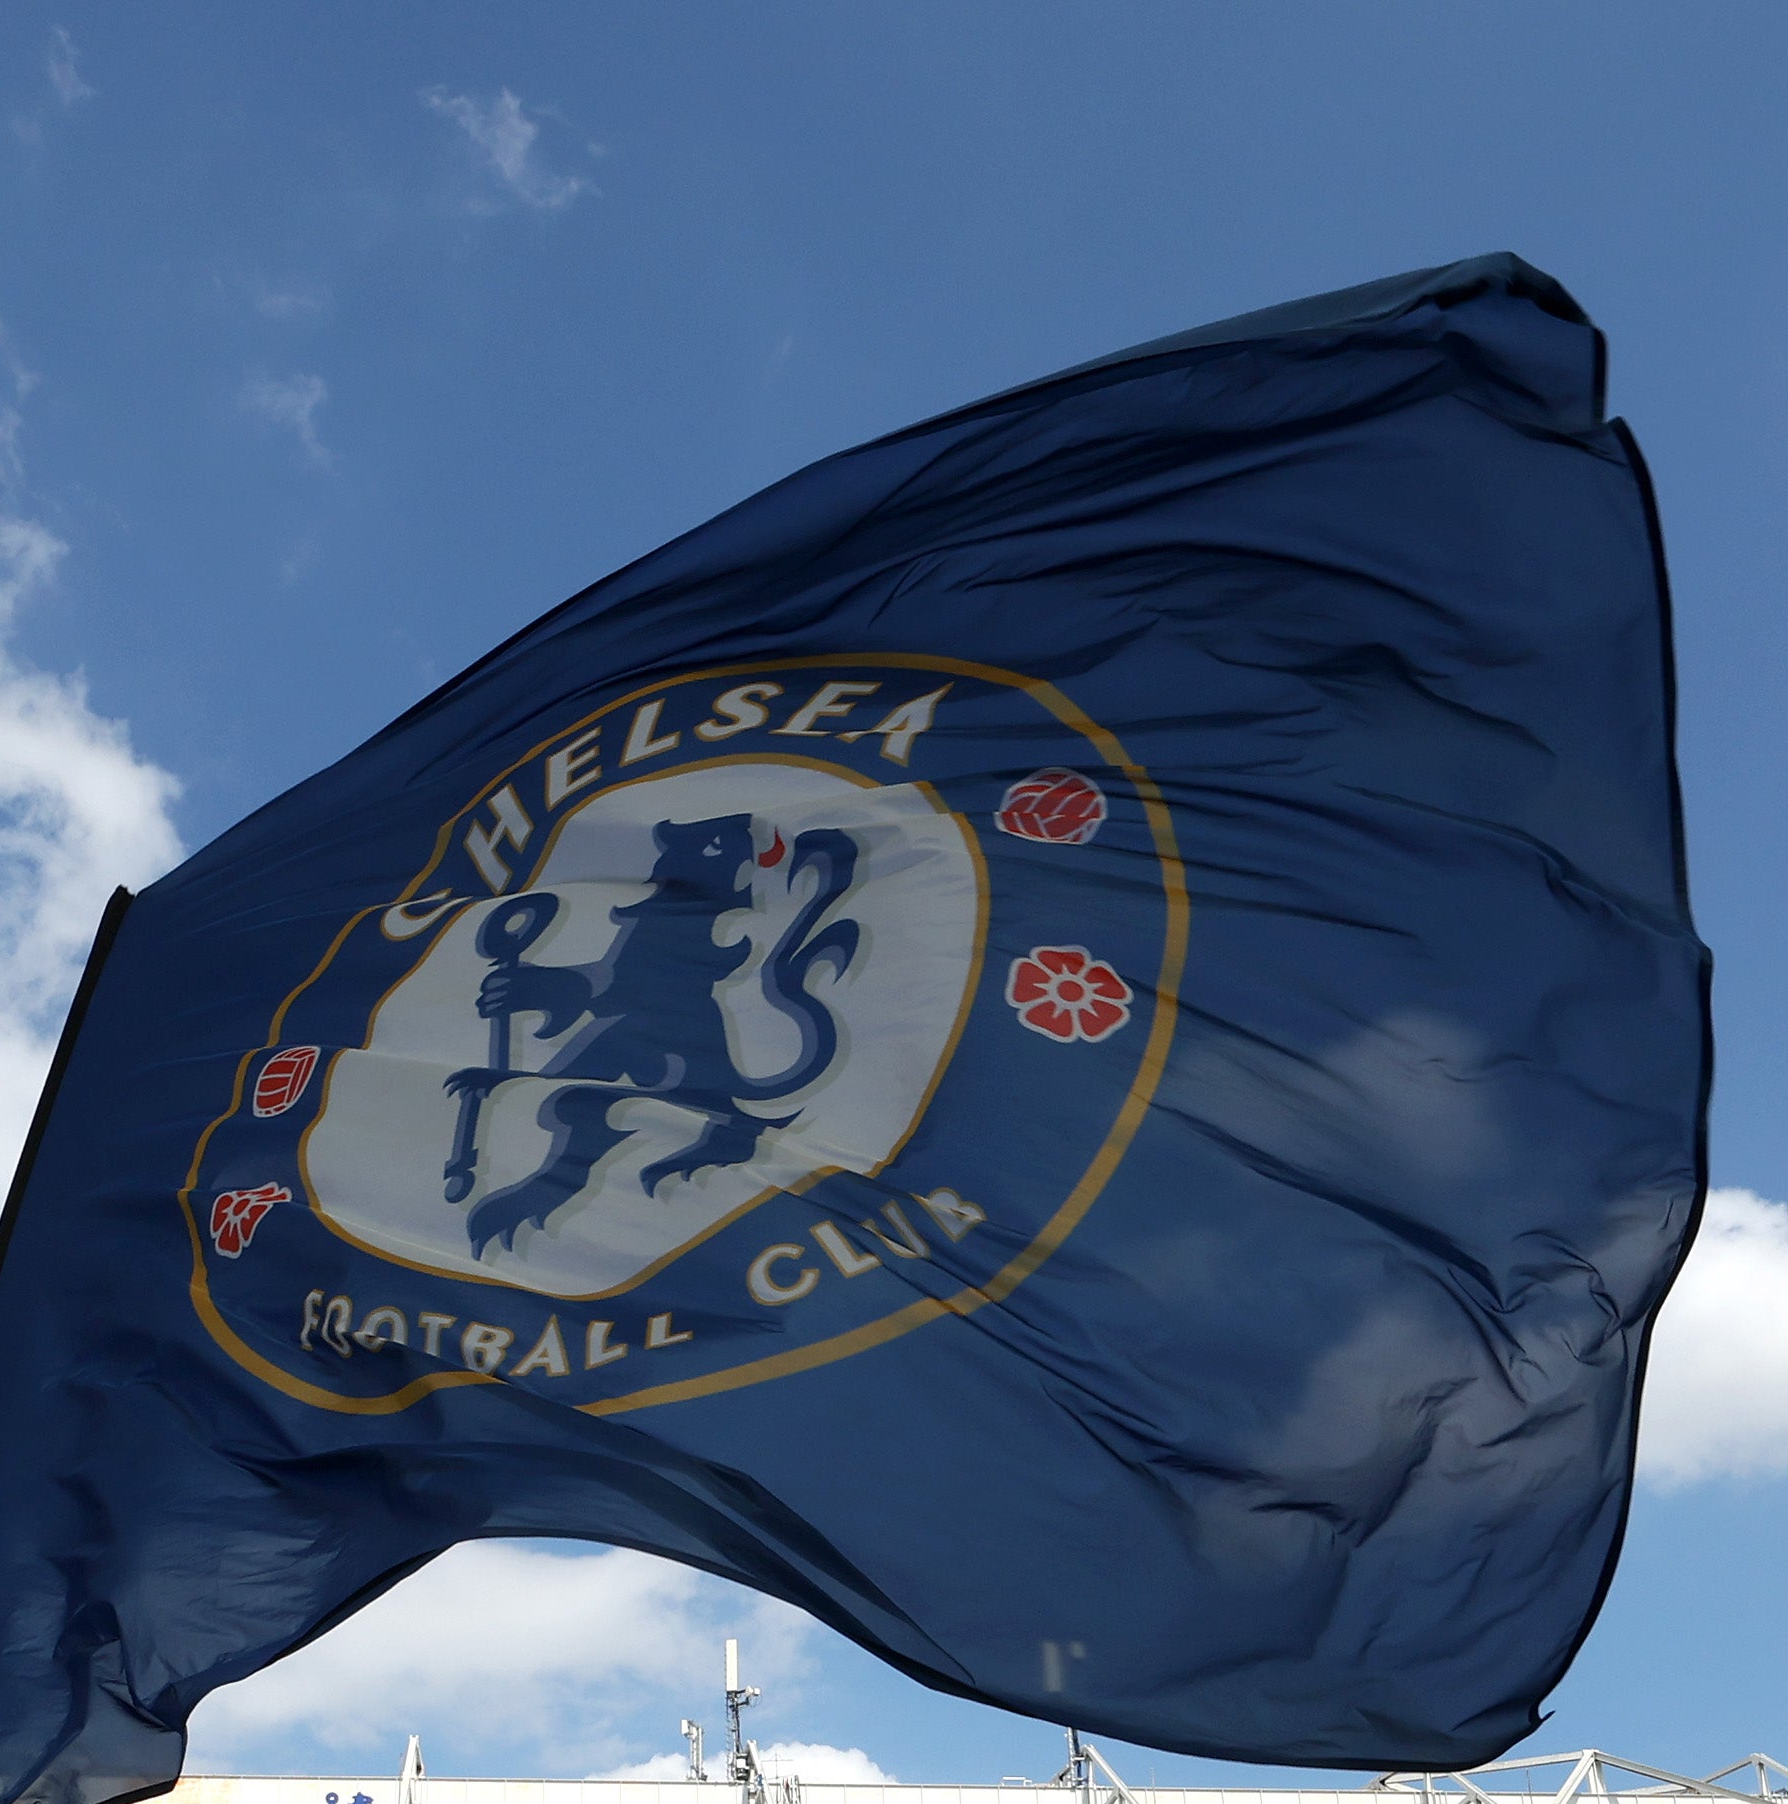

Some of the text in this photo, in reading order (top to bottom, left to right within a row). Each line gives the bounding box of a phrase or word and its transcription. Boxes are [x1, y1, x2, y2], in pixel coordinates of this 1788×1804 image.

[380, 681, 954, 942] CHELSEA
[301, 1187, 987, 1377] FOOTBALL CLUB
